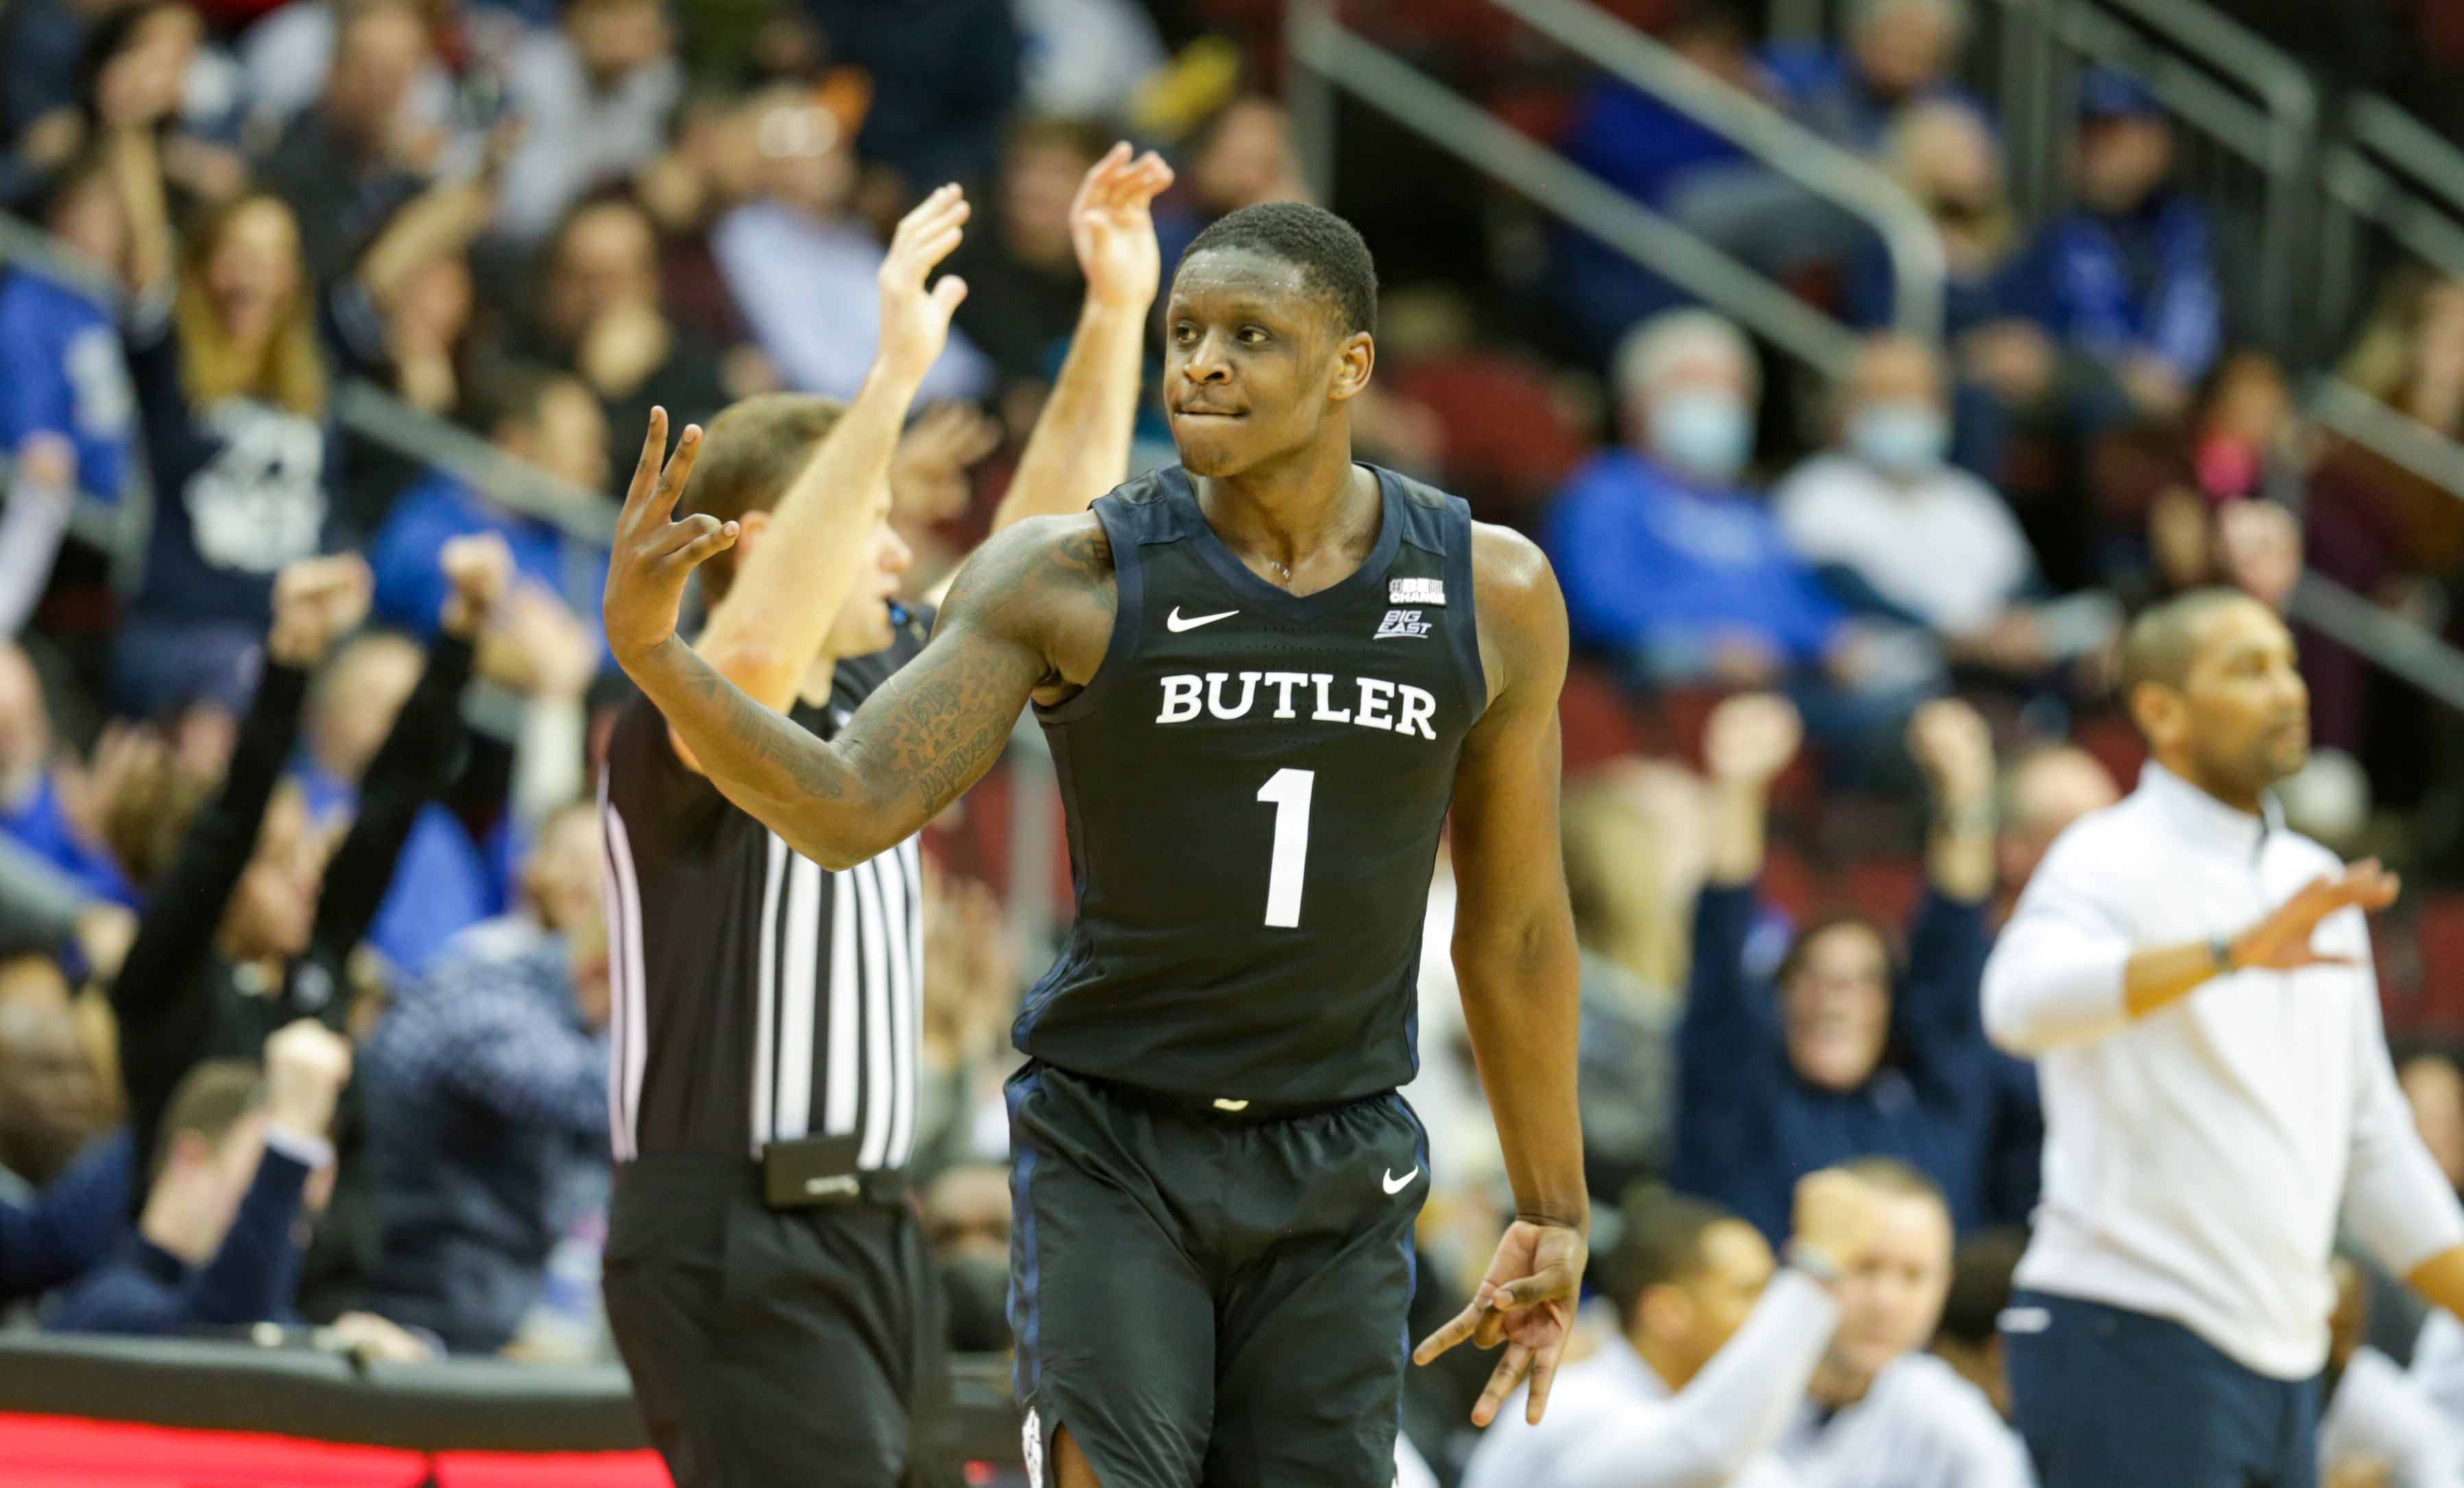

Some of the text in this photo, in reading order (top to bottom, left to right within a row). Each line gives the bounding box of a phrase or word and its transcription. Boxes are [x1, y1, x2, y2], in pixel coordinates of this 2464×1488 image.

[1377, 622, 1432, 634] EAST
[1384, 609, 1423, 623] BIG
[1155, 672, 1436, 740] BUTLER
[1257, 768, 1315, 928] 1
